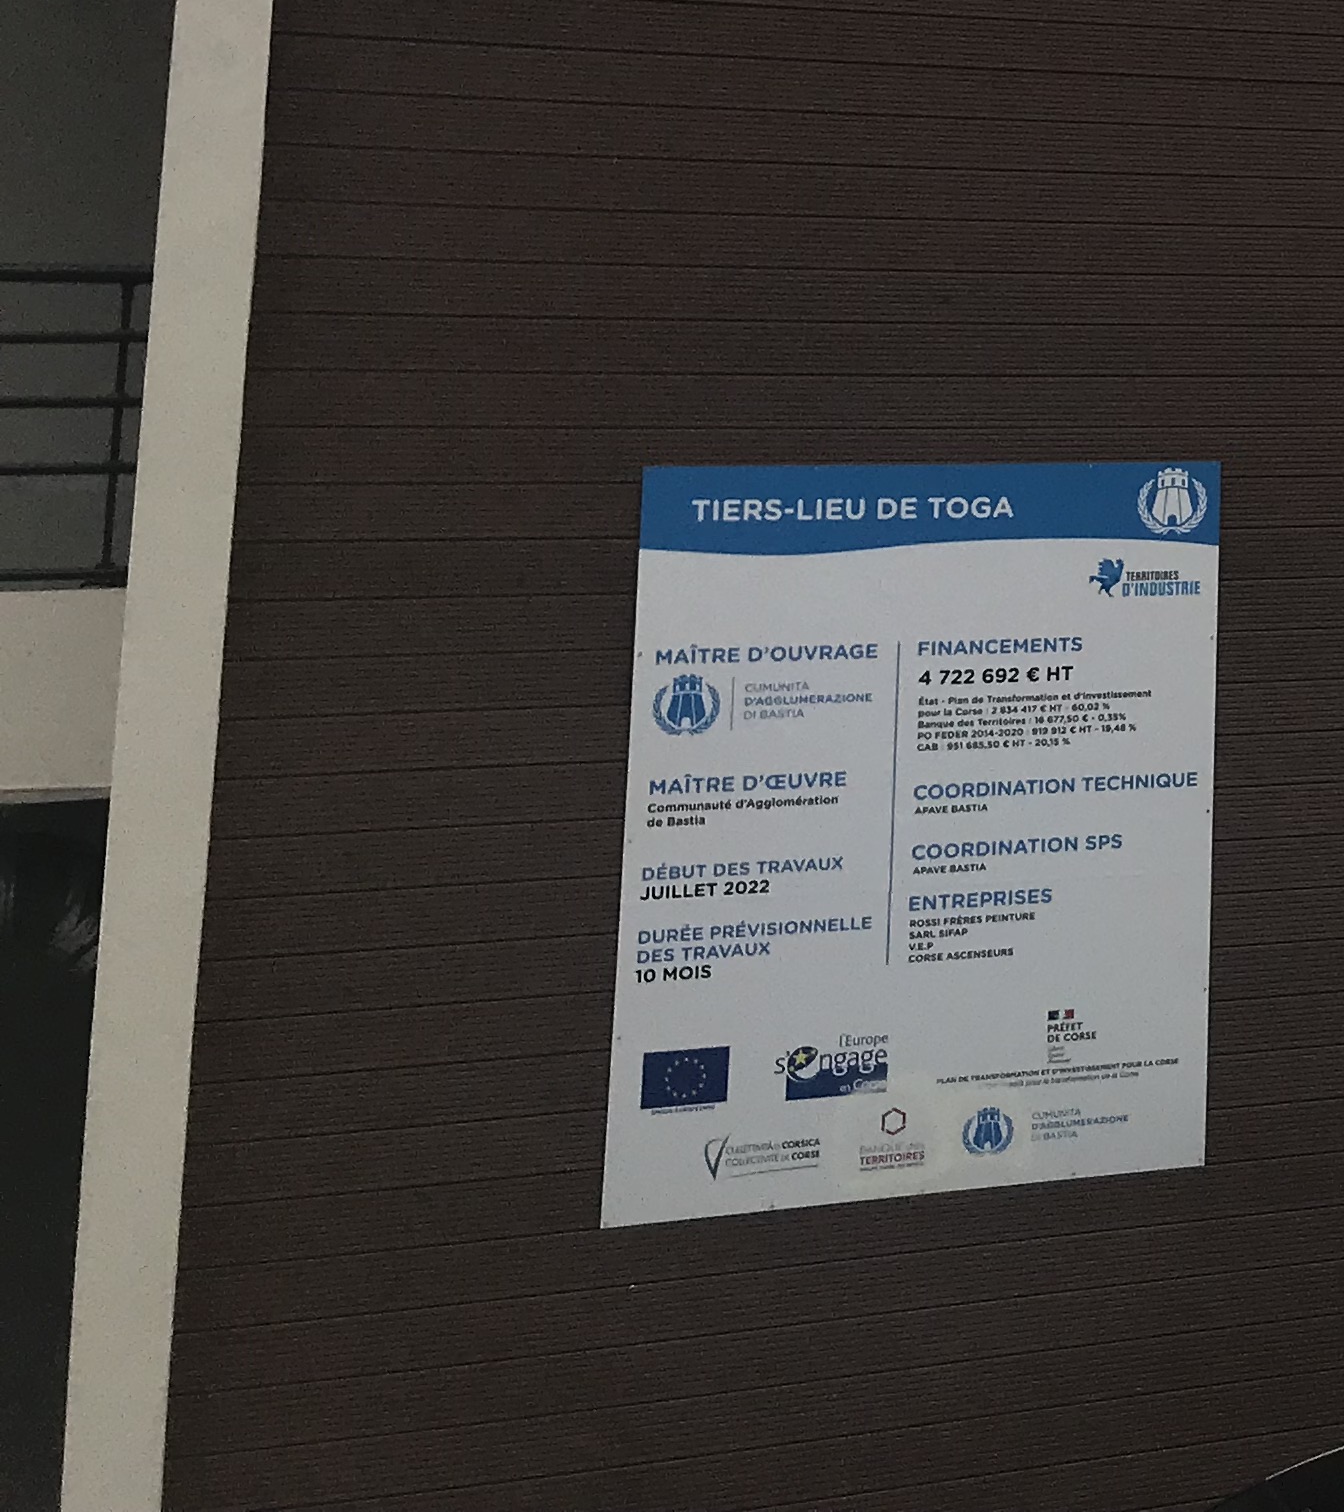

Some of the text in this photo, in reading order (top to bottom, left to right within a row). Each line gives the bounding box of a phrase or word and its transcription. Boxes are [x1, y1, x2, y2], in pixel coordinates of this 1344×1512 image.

[692, 496, 1014, 522] TIERS-LIEU DE TOGA
[1126, 571, 1179, 581] TERRITOIRES
[1122, 581, 1201, 597] D'INDUSTRIE
[655, 643, 878, 665] MAÎTRE D'OUVRAGE
[917, 637, 1083, 656] FINANCEMENTS
[919, 666, 1073, 685] 4 722 692 € HT
[948, 696, 969, 705] Plan
[971, 695, 984, 704] de
[987, 694, 1059, 704] Transformation
[1061, 693, 1071, 701] et
[744, 708, 804, 720] DI BASTIA
[918, 710, 941, 719] pour
[955, 707, 983, 716] Corse
[1021, 705, 1038, 713] 417
[1049, 704, 1062, 712] HT
[918, 720, 954, 730] Banque
[957, 719, 974, 728] des
[978, 716, 1026, 726] Territoires
[917, 731, 932, 740] PO
[934, 730, 968, 739] FEDER
[971, 728, 1024, 739] 2014-2020
[1079, 725, 1092, 734] HT
[917, 742, 938, 751] CAB
[1012, 739, 1025, 747] HT
[649, 771, 846, 795] MAÎTRE D'ŒUVRE
[913, 772, 1198, 801] COORDINATION TECHNIQUE
[647, 795, 839, 814] Communauté d'Agglomération
[914, 803, 988, 815] APAVE BASTIA
[646, 815, 705, 827] de Bastia
[911, 834, 1123, 861] COORDINATION SPS
[641, 856, 843, 881] DÉBUT DES TRAVAUX
[912, 862, 987, 875] APAVE BASTIA
[640, 879, 770, 901] JUILLET 2022
[909, 888, 1052, 911] ENTREPRISES
[909, 918, 940, 928] ROSSI
[985, 912, 1036, 924] PEINTURE
[638, 916, 872, 945] DURÉE PRÉVISIONNELLE
[909, 928, 968, 940] SARL SIFAP
[637, 941, 771, 964] DES TRAVAUX
[908, 947, 1014, 963] CORSE ASCENSEURS
[635, 965, 712, 983] 10 MOIS
[1047, 1021, 1083, 1033] PRÉFET
[1047, 1031, 1096, 1043] DE CORSE
[782, 1138, 820, 1150] CORSICA
[860, 1151, 925, 1166] TERRITOIRES
